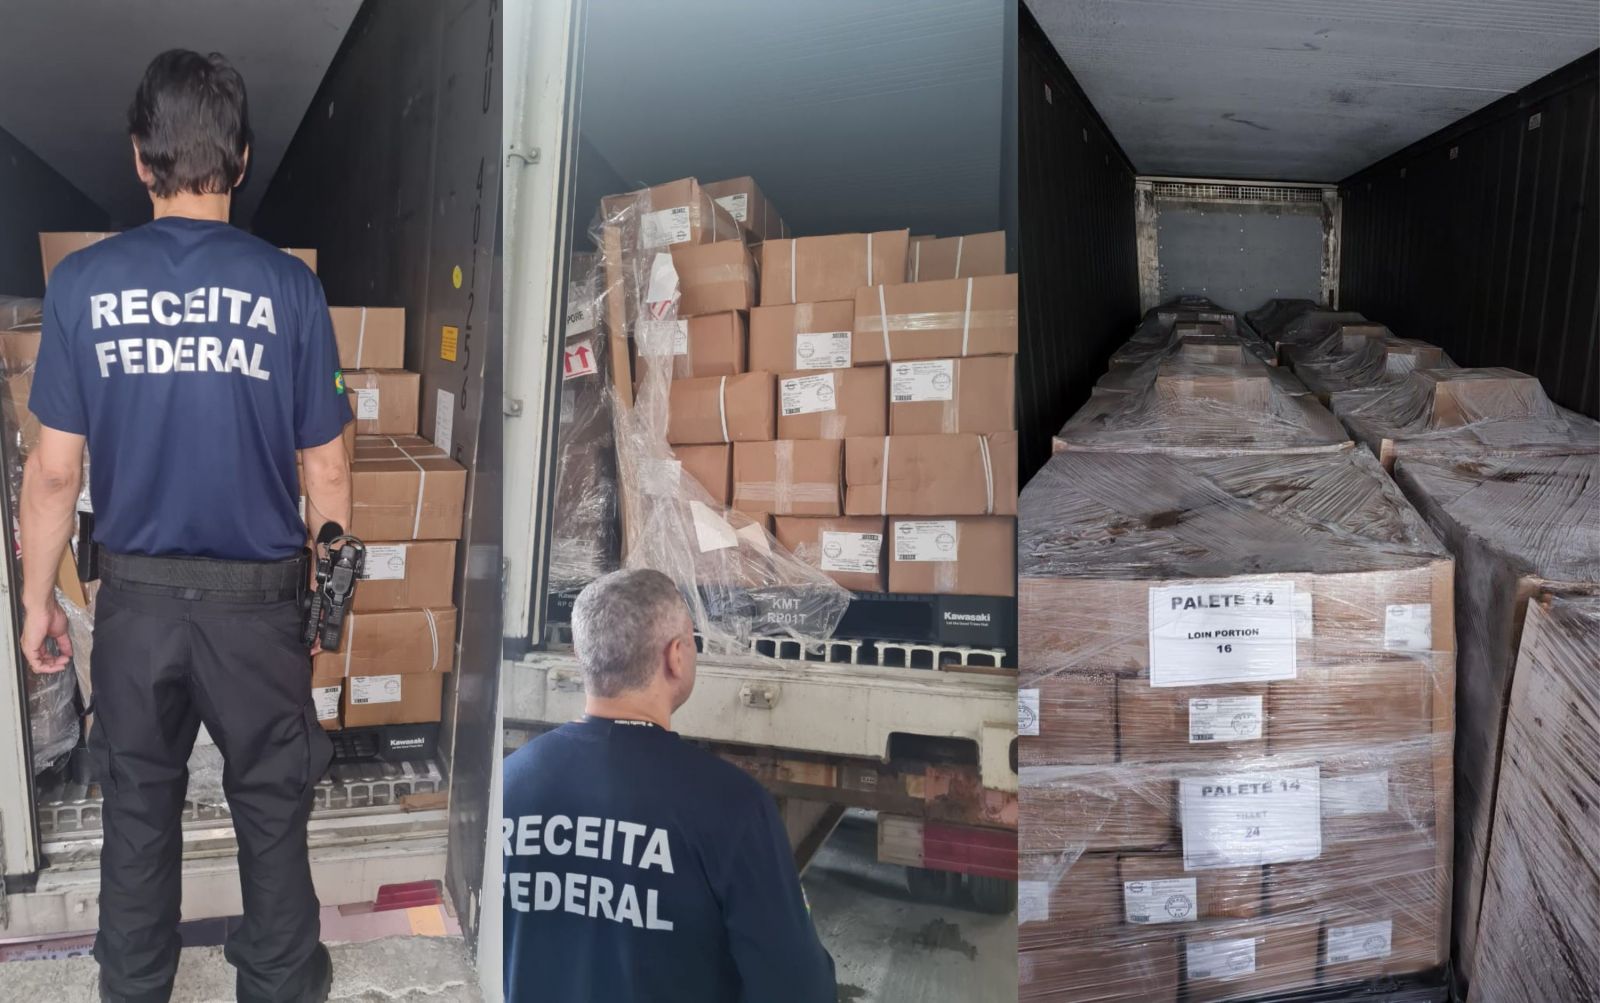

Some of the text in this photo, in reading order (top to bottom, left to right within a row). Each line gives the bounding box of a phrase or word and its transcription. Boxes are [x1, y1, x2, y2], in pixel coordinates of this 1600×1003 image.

[90, 287, 277, 334] RECEITA
[95, 336, 270, 380] FEDERAL
[772, 598, 801, 609] KMT
[1171, 592, 1275, 610] PALETE 14
[944, 612, 991, 622] Kawasaki
[1188, 628, 1260, 640] LOIN PORTION
[1216, 644, 1233, 653] 16
[1201, 779, 1301, 797] PALETE 14
[503, 815, 675, 874] RECEITA
[503, 872, 674, 931] EDERAL
